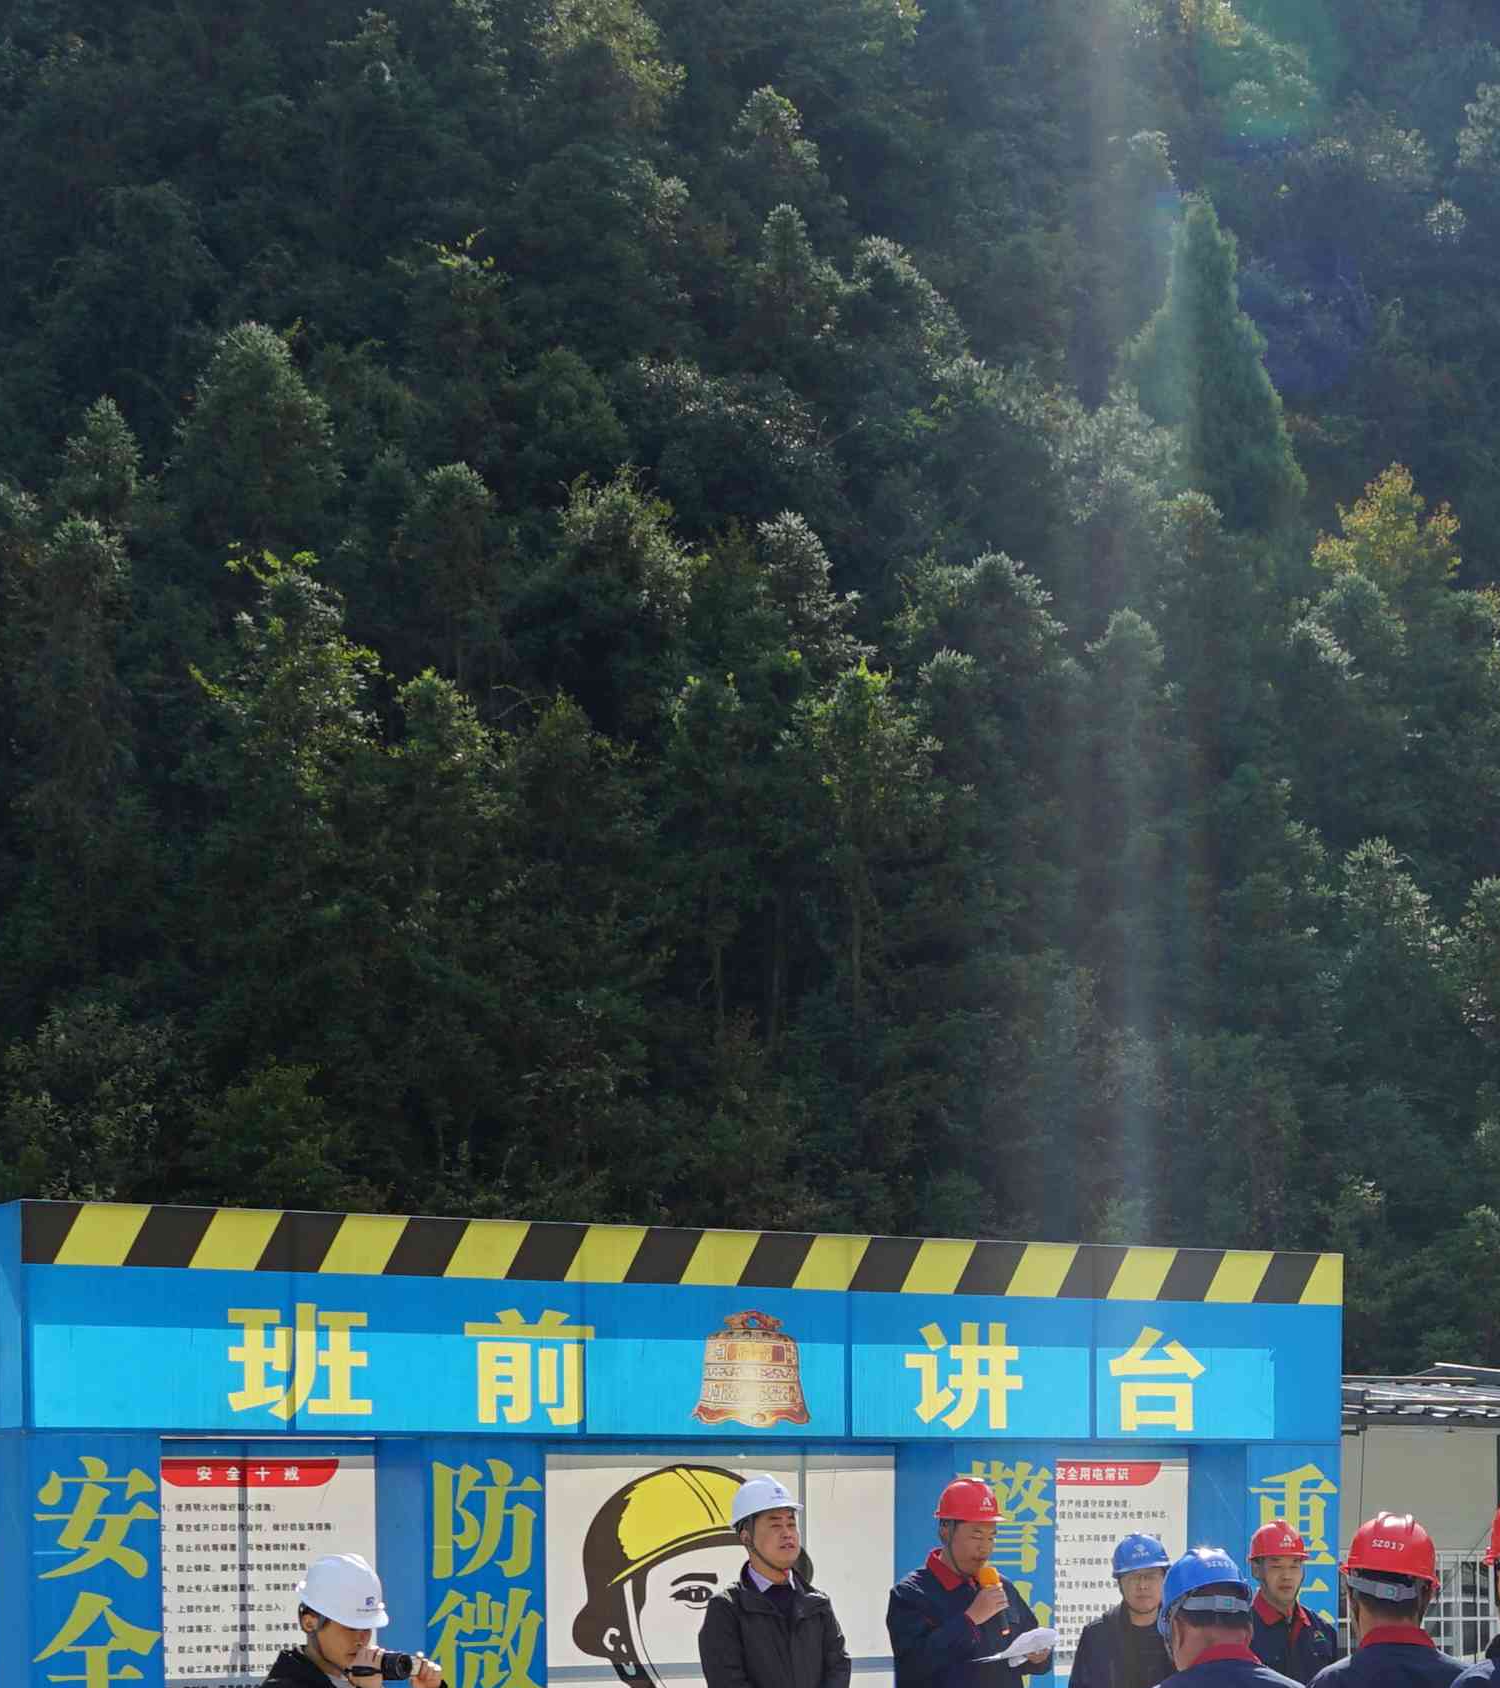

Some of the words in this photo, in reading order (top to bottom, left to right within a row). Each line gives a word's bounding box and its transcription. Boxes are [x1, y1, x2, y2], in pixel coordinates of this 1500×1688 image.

[228, 1303, 595, 1425] 班前
[904, 1322, 1206, 1431] 讲台
[196, 1466, 300, 1482] 安全十戒
[1056, 1466, 1130, 1481] 安全用电常识
